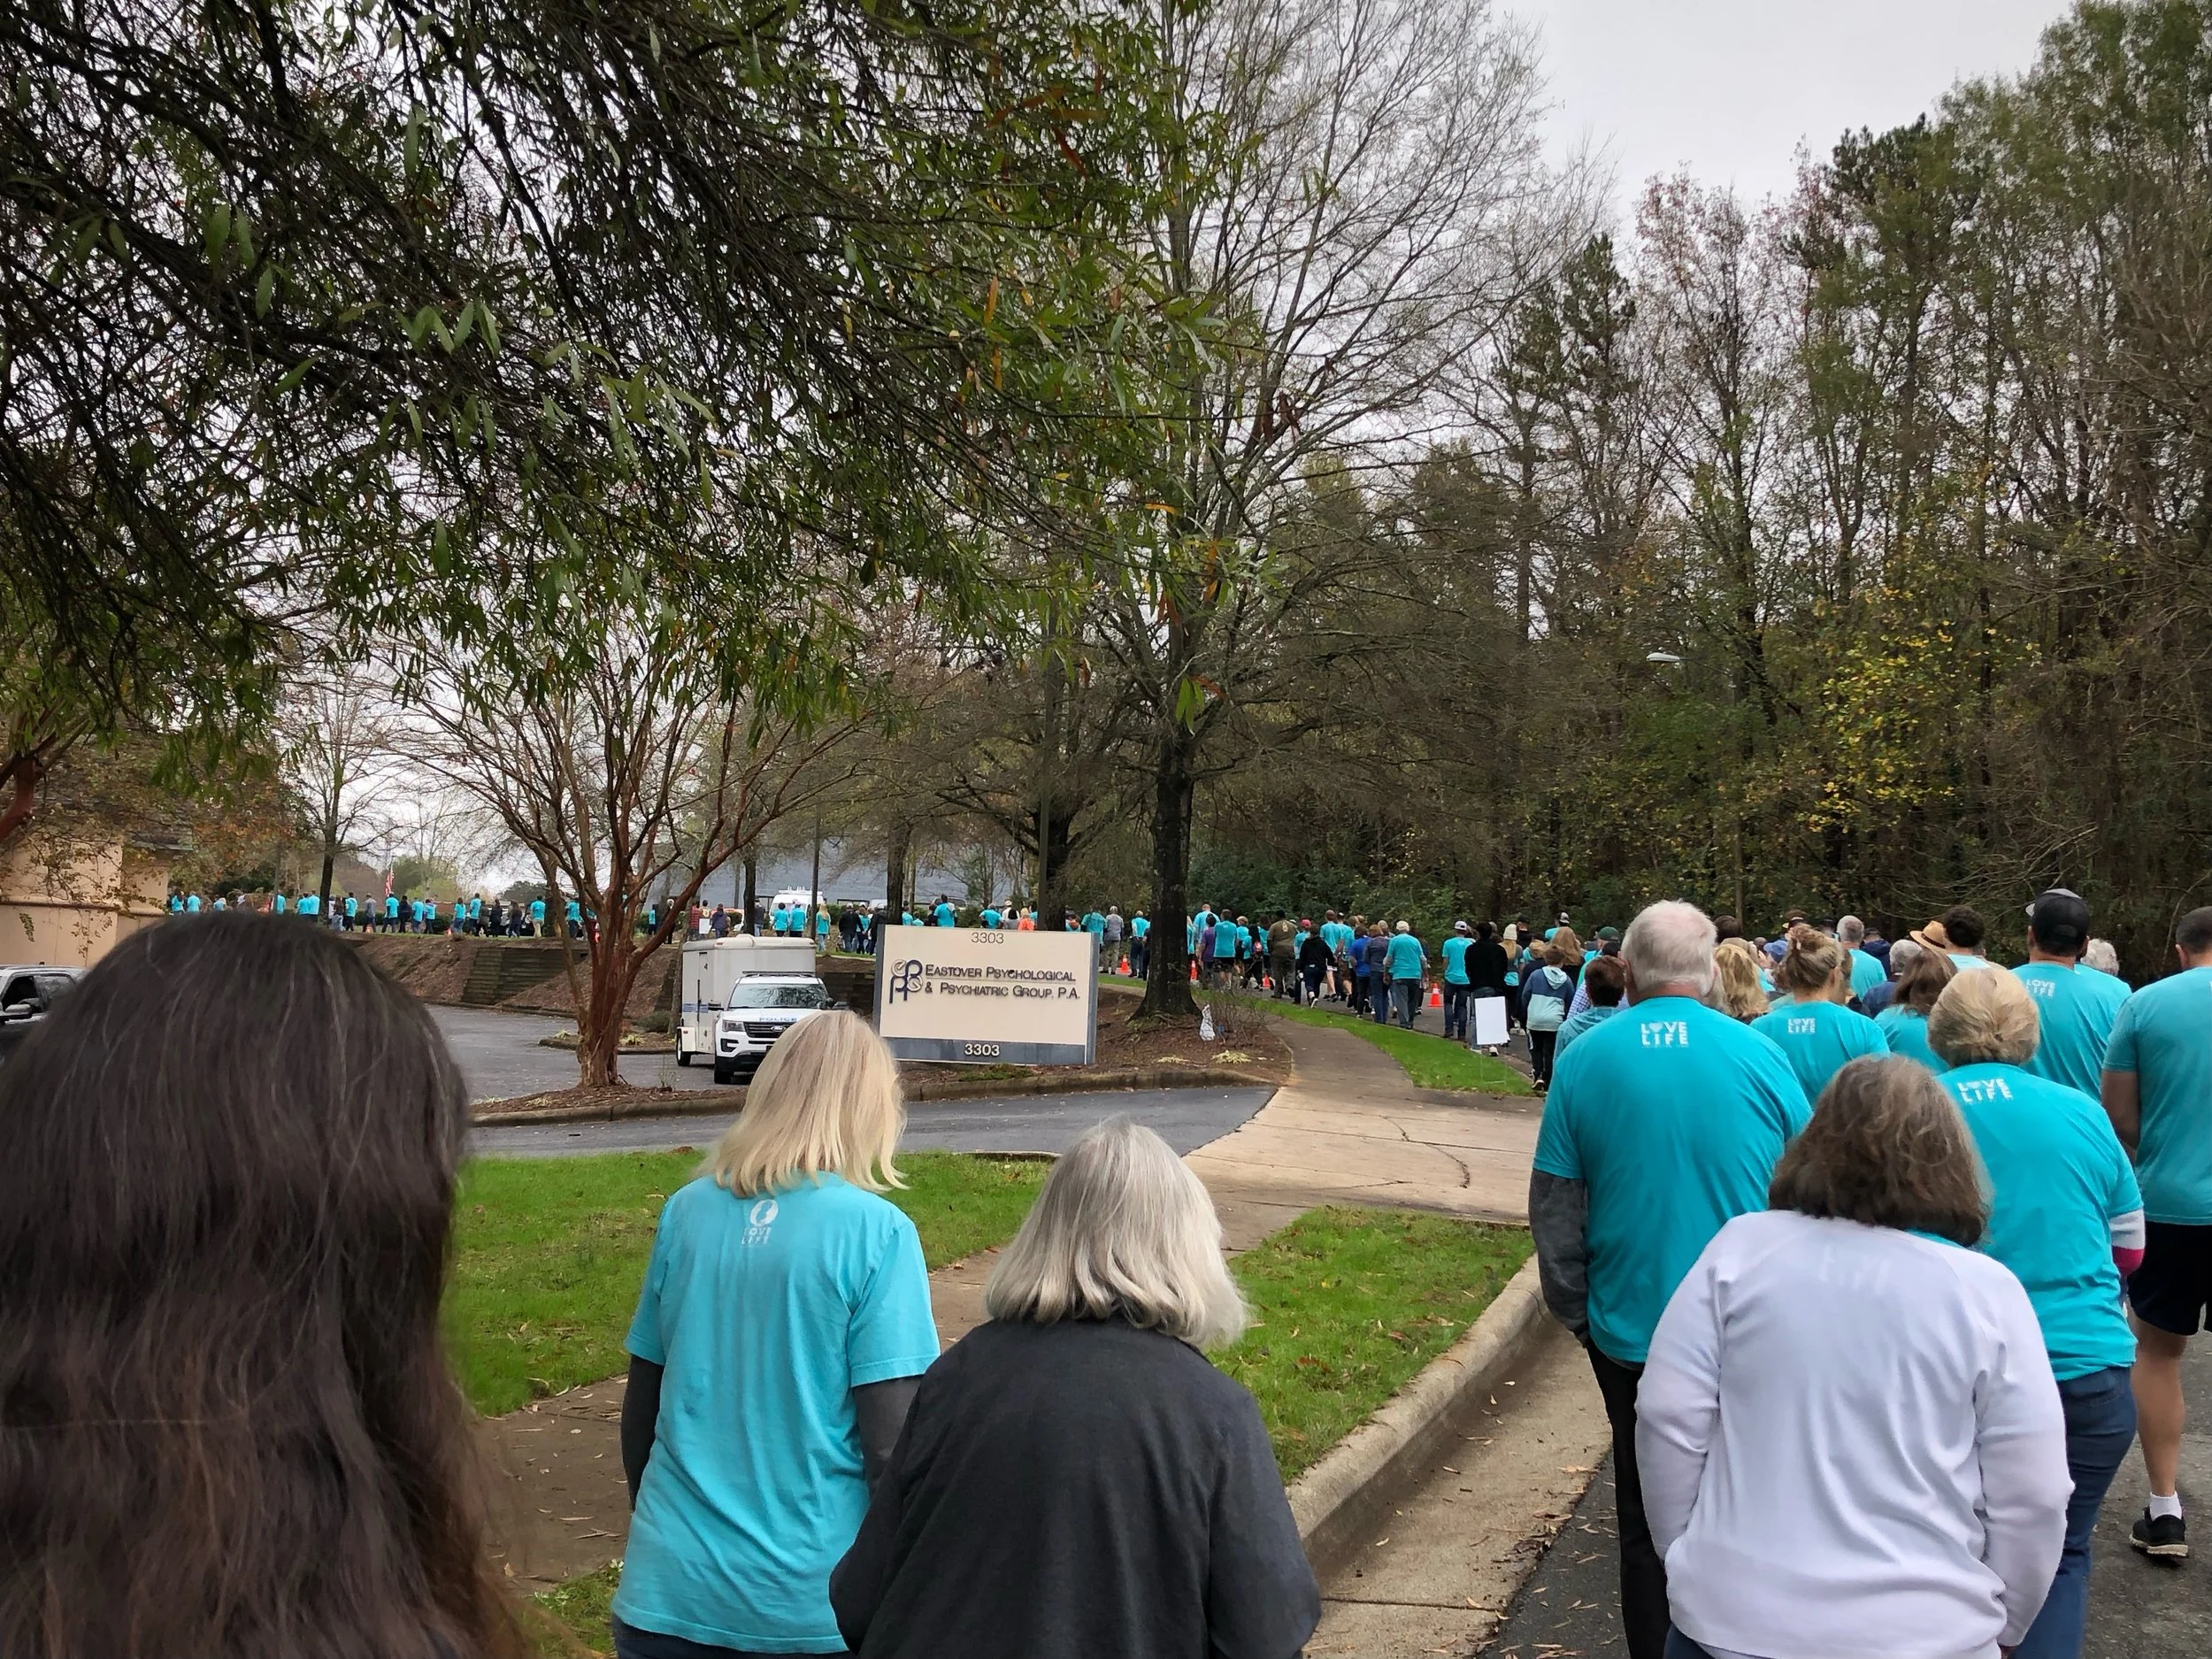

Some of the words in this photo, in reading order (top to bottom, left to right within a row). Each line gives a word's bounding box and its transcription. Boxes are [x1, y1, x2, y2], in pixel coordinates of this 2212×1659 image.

[971, 932, 1004, 944] 3303
[926, 964, 982, 978] EASTOVER
[987, 966, 1076, 981] PSYCHOLOGICAL
[925, 982, 933, 994] &
[940, 982, 1009, 996] PSYCHIATRIC
[1057, 988, 1081, 999] P.A.
[2026, 979, 2055, 989] LOVE
[1641, 1033, 1688, 1046] LIFE
[964, 1043, 1001, 1056] 3303
[1961, 1087, 2013, 1102] LIFE
[743, 1227, 772, 1236] LOVE
[741, 1236, 770, 1245] LIFE
